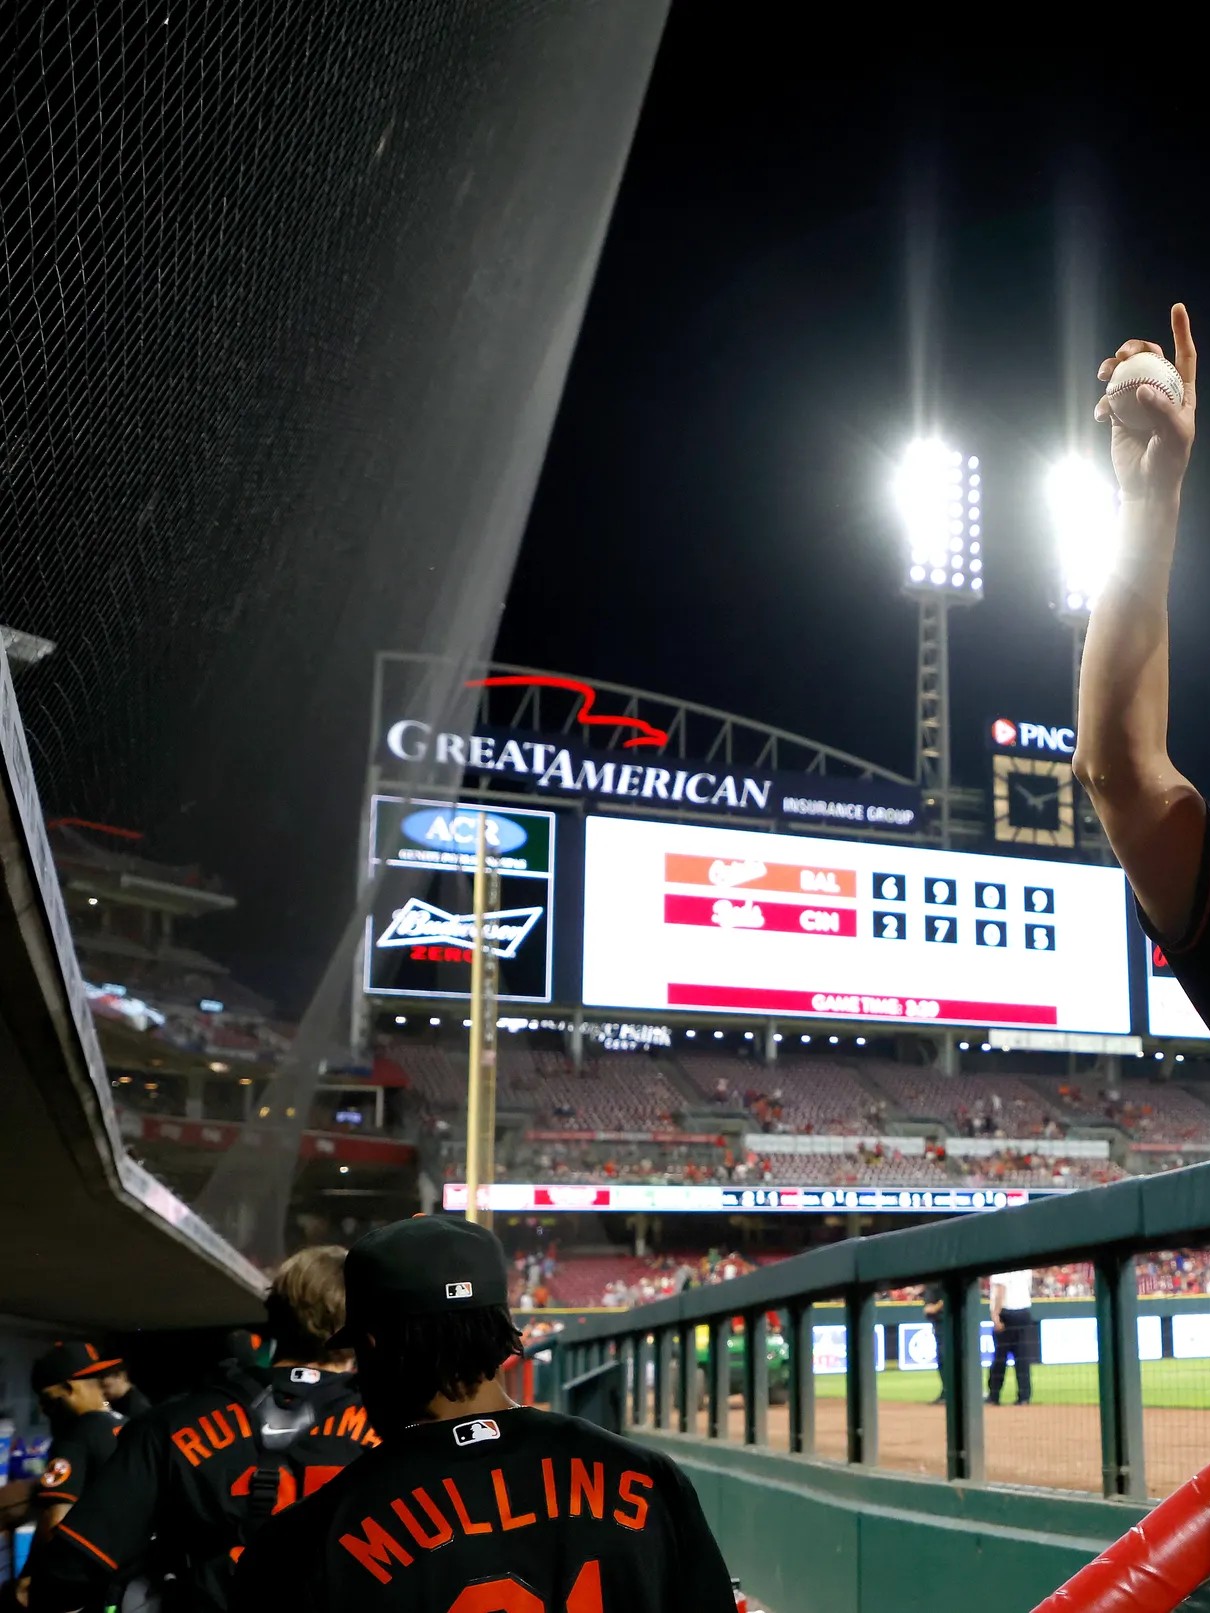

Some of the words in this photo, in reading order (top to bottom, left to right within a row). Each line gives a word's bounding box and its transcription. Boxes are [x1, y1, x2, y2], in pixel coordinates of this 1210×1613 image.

[1018, 722, 1076, 753] PNC
[782, 796, 864, 821] INSURANCE
[866, 805, 915, 826] GROUP
[424, 815, 501, 847] ACR
[800, 869, 841, 894] BAL
[880, 875, 899, 900] 6
[932, 880, 950, 903] 9
[981, 884, 1000, 908] 0
[1030, 889, 1049, 912] 9
[799, 909, 840, 932] CIN
[881, 915, 899, 939] 2
[934, 919, 951, 942] 7
[983, 922, 1001, 947] 0
[1032, 927, 1050, 951] 5
[811, 993, 861, 1013] GAME
[338, 1457, 655, 1585] MULLINS
